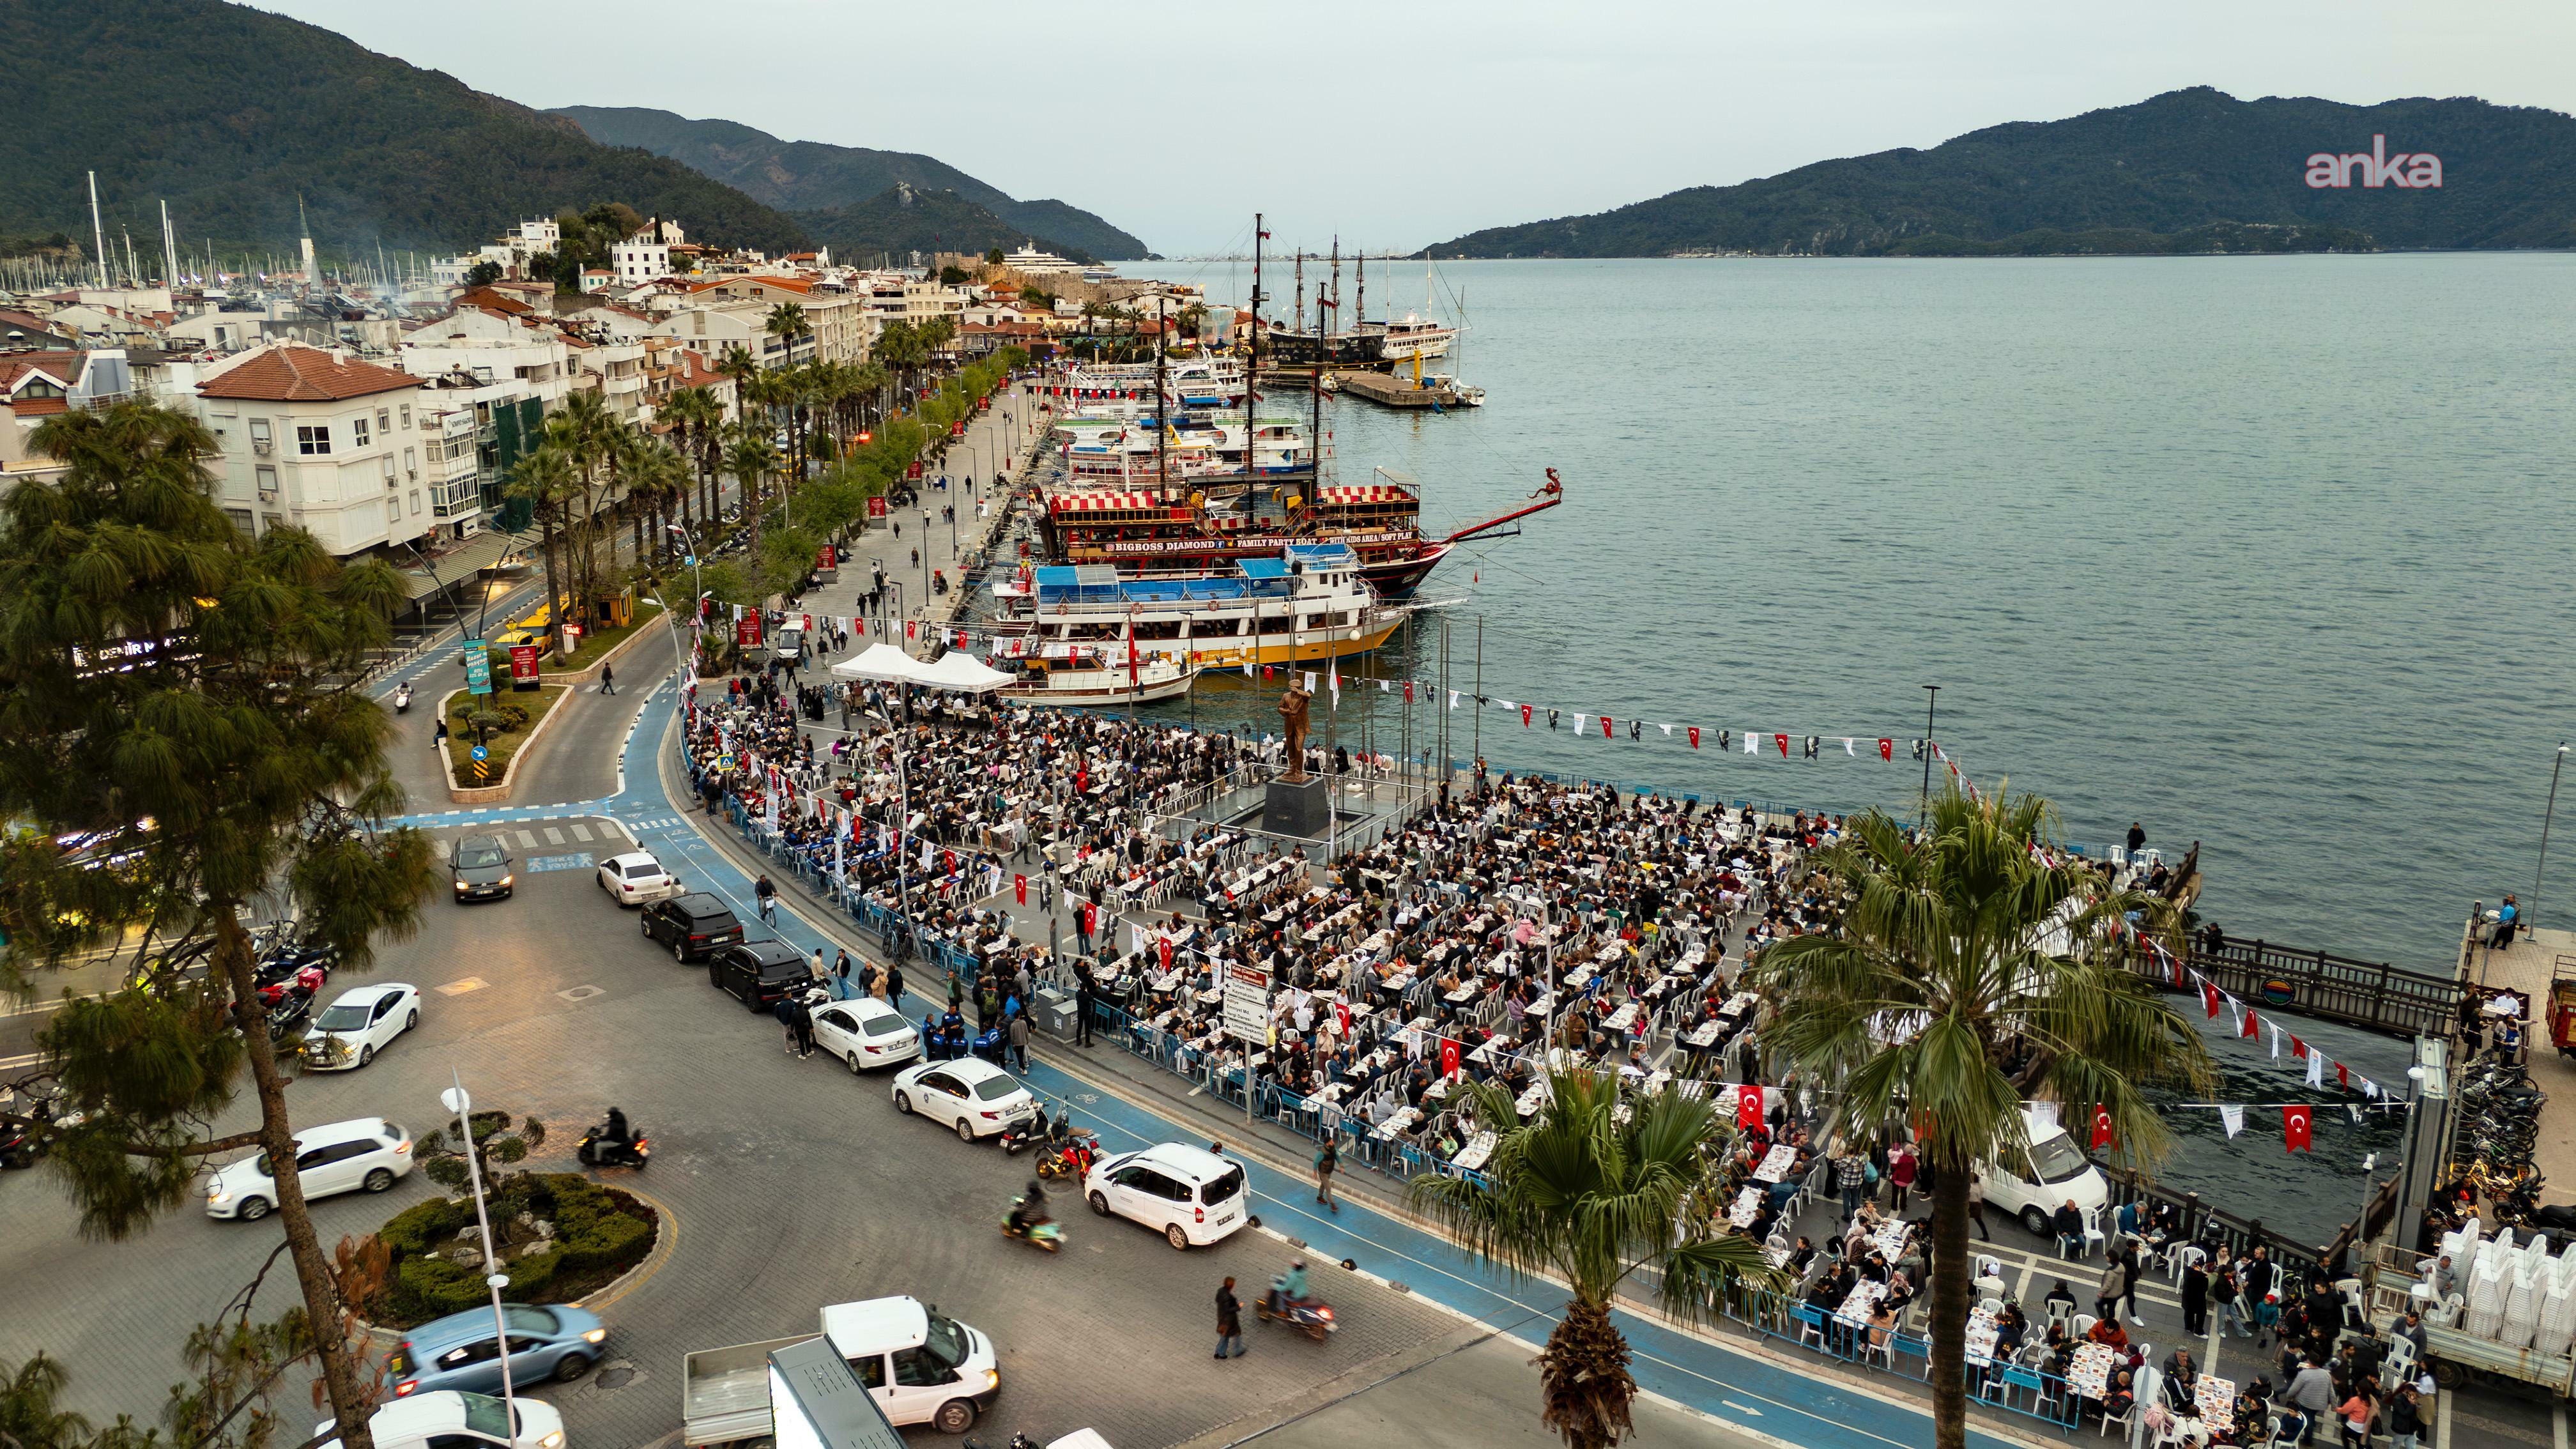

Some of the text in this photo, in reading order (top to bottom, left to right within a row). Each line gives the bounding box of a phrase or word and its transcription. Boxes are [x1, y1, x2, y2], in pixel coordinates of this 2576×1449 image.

[1115, 542, 1163, 552] BIGBOSS
[1166, 540, 1215, 551] DIAMOND
[1237, 539, 1264, 548] FAMILY
[1265, 538, 1294, 547] PARTY
[1296, 537, 1317, 546] BOAT
[1397, 532, 1413, 540] PLAY
[1241, 968, 1257, 977] (Castle)
[1227, 1010, 1237, 1018] Vergi
